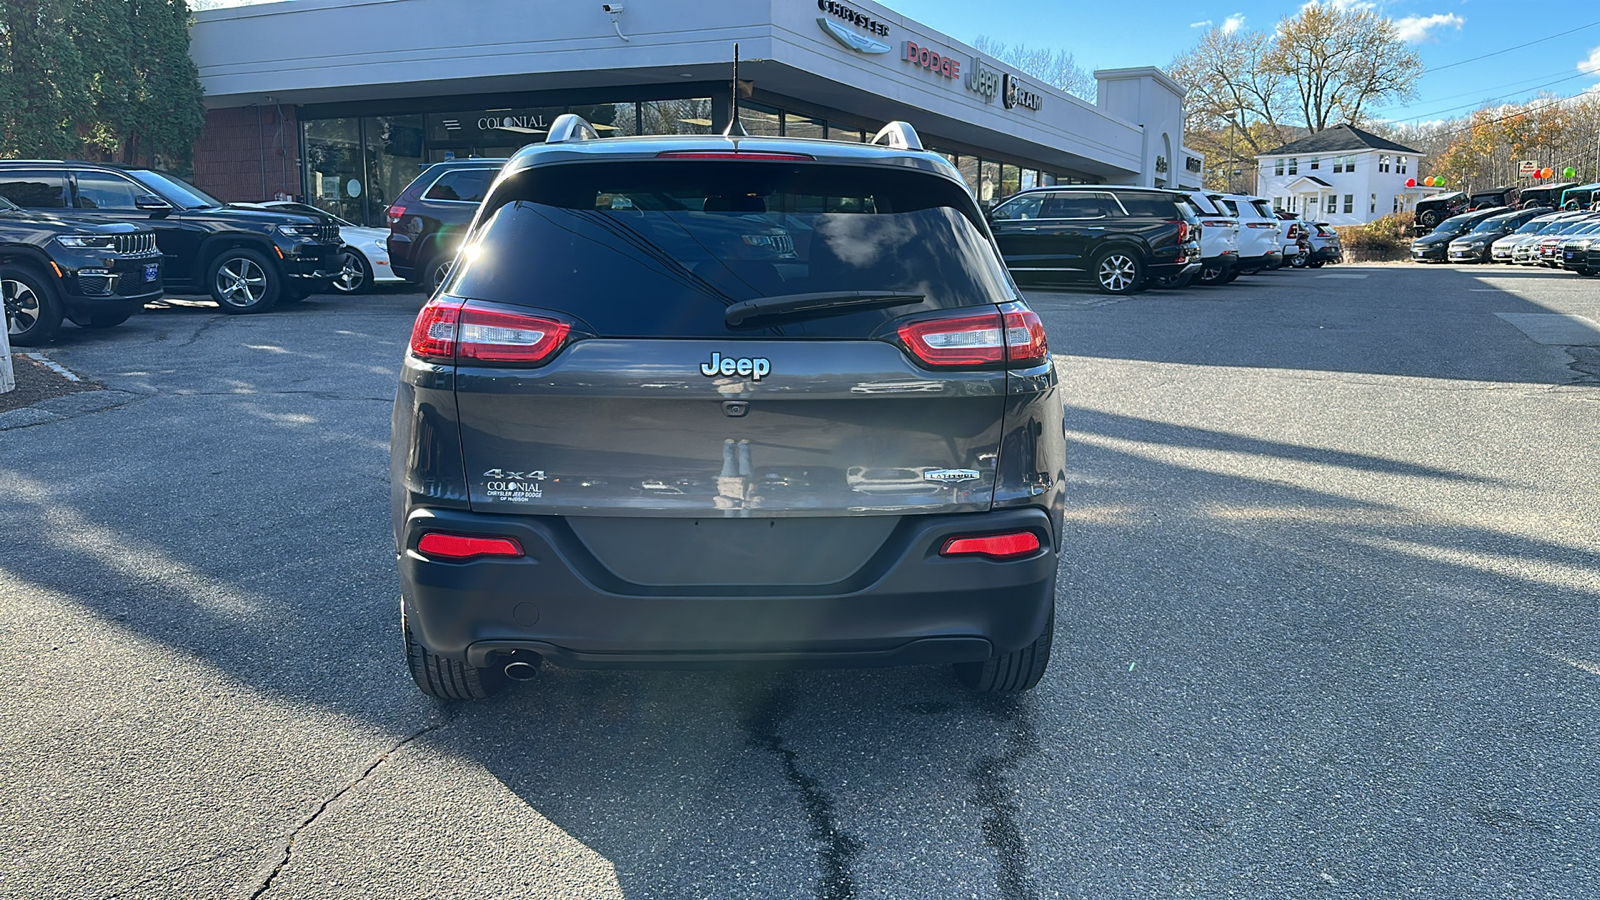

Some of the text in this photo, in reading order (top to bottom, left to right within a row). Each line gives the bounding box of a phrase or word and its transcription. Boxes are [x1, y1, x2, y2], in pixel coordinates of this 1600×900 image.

[818, 0, 890, 36] CHRYSLER
[903, 41, 961, 80] DODGE
[966, 57, 1000, 102] Jeep
[1018, 88, 1042, 111] RAM
[477, 114, 548, 131] COLONIAL
[701, 352, 771, 382] Jeep
[483, 468, 548, 481] 4x4
[487, 481, 542, 492] COLONIAL
